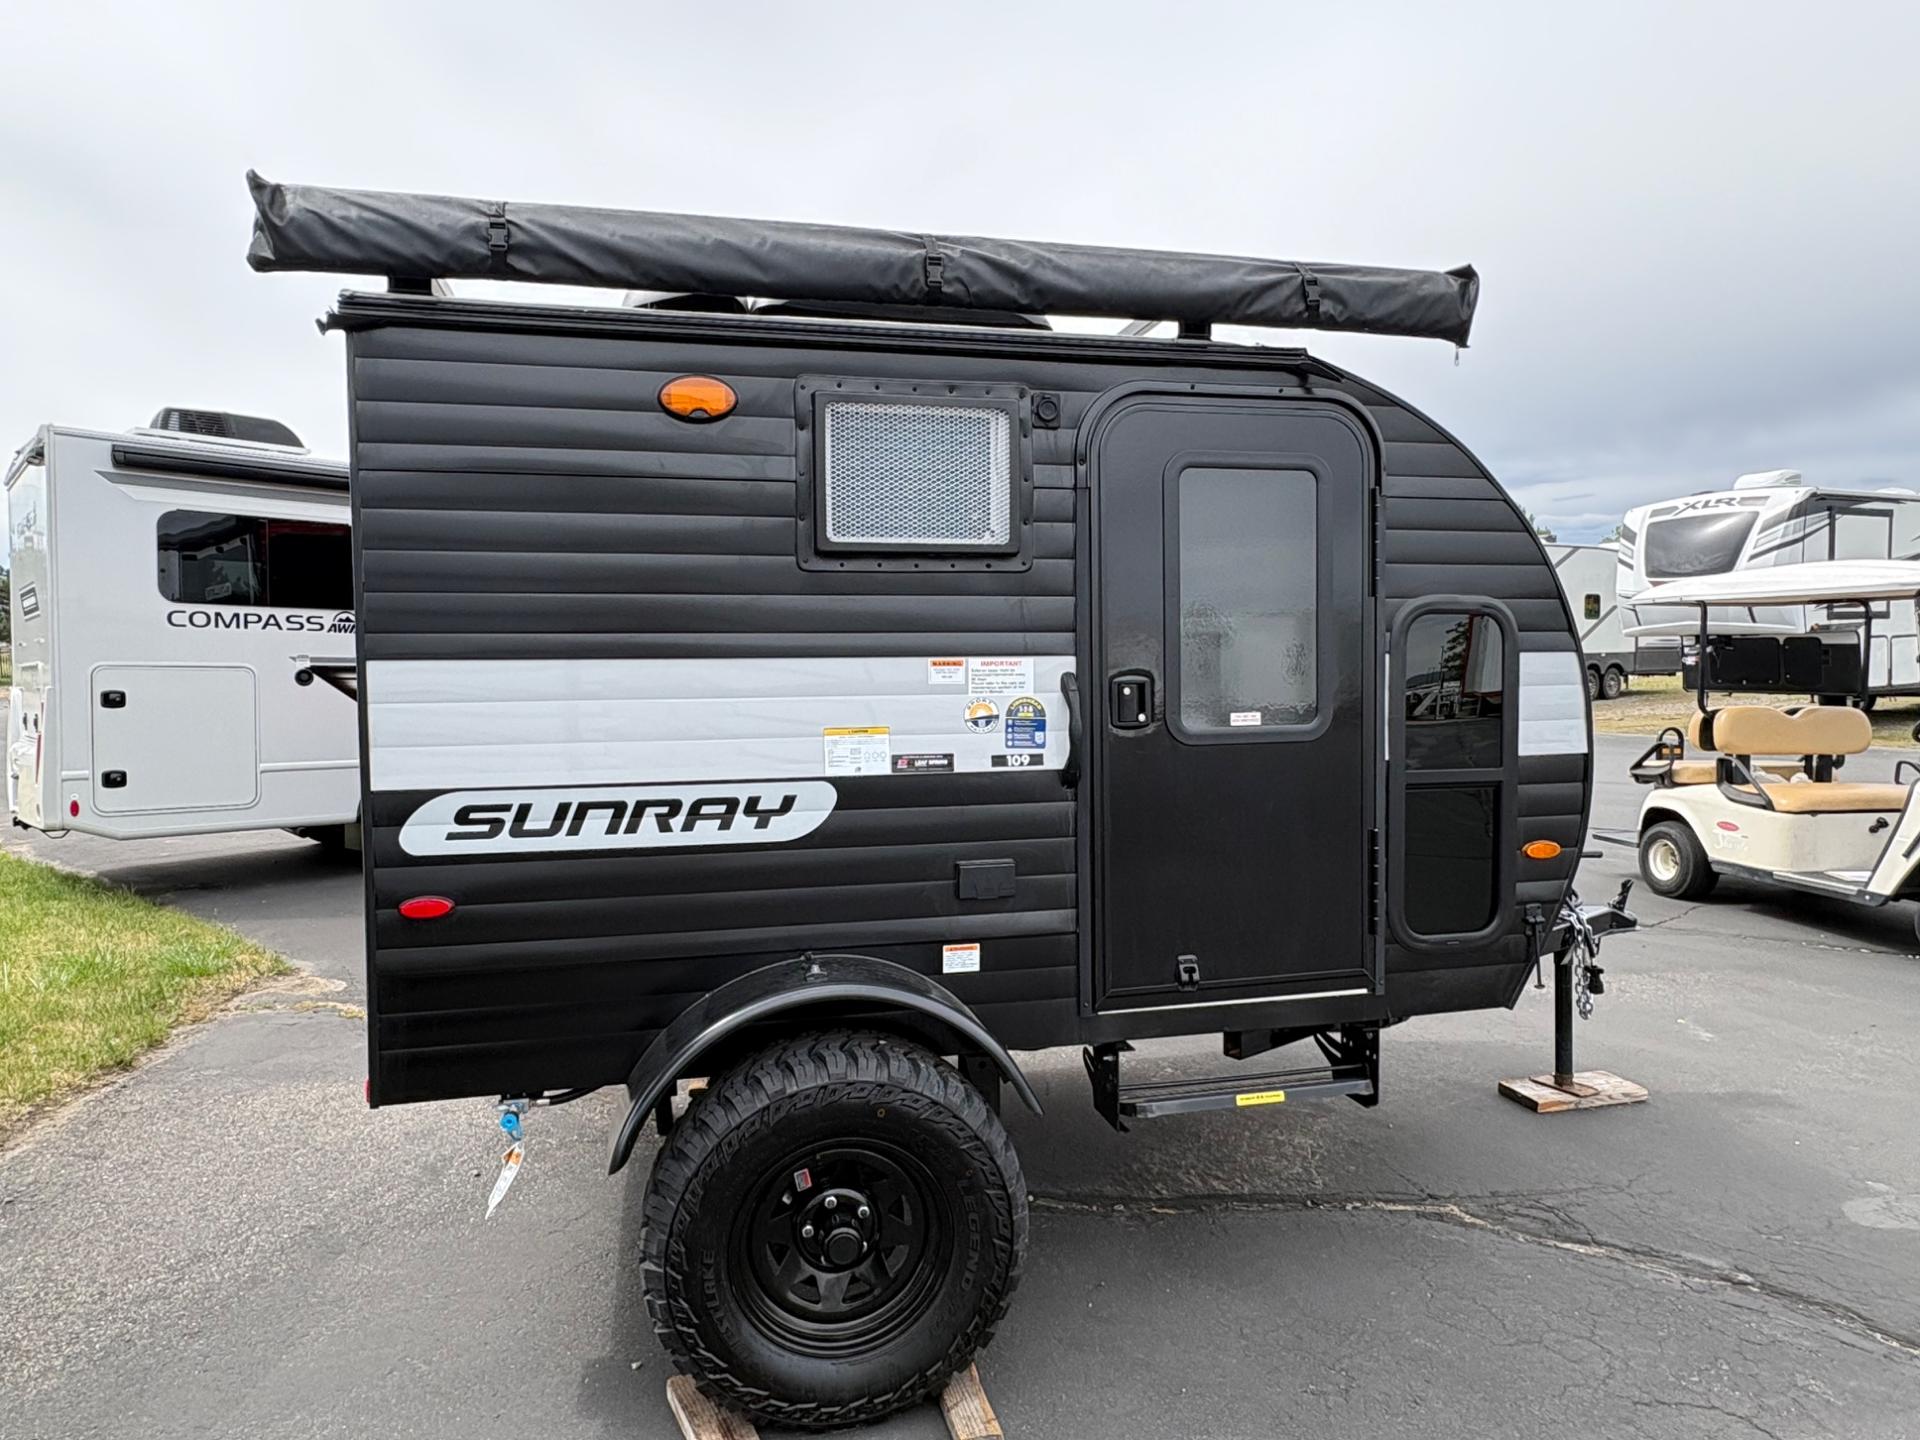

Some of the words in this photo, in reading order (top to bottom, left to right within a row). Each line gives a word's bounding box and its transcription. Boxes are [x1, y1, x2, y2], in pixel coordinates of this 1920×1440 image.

[1672, 498, 1737, 516] XLR
[166, 610, 325, 632] COMPASS
[1006, 754, 1031, 767] 109
[444, 794, 798, 841] SUNRAY
[957, 1183, 980, 1291] LEGEND
